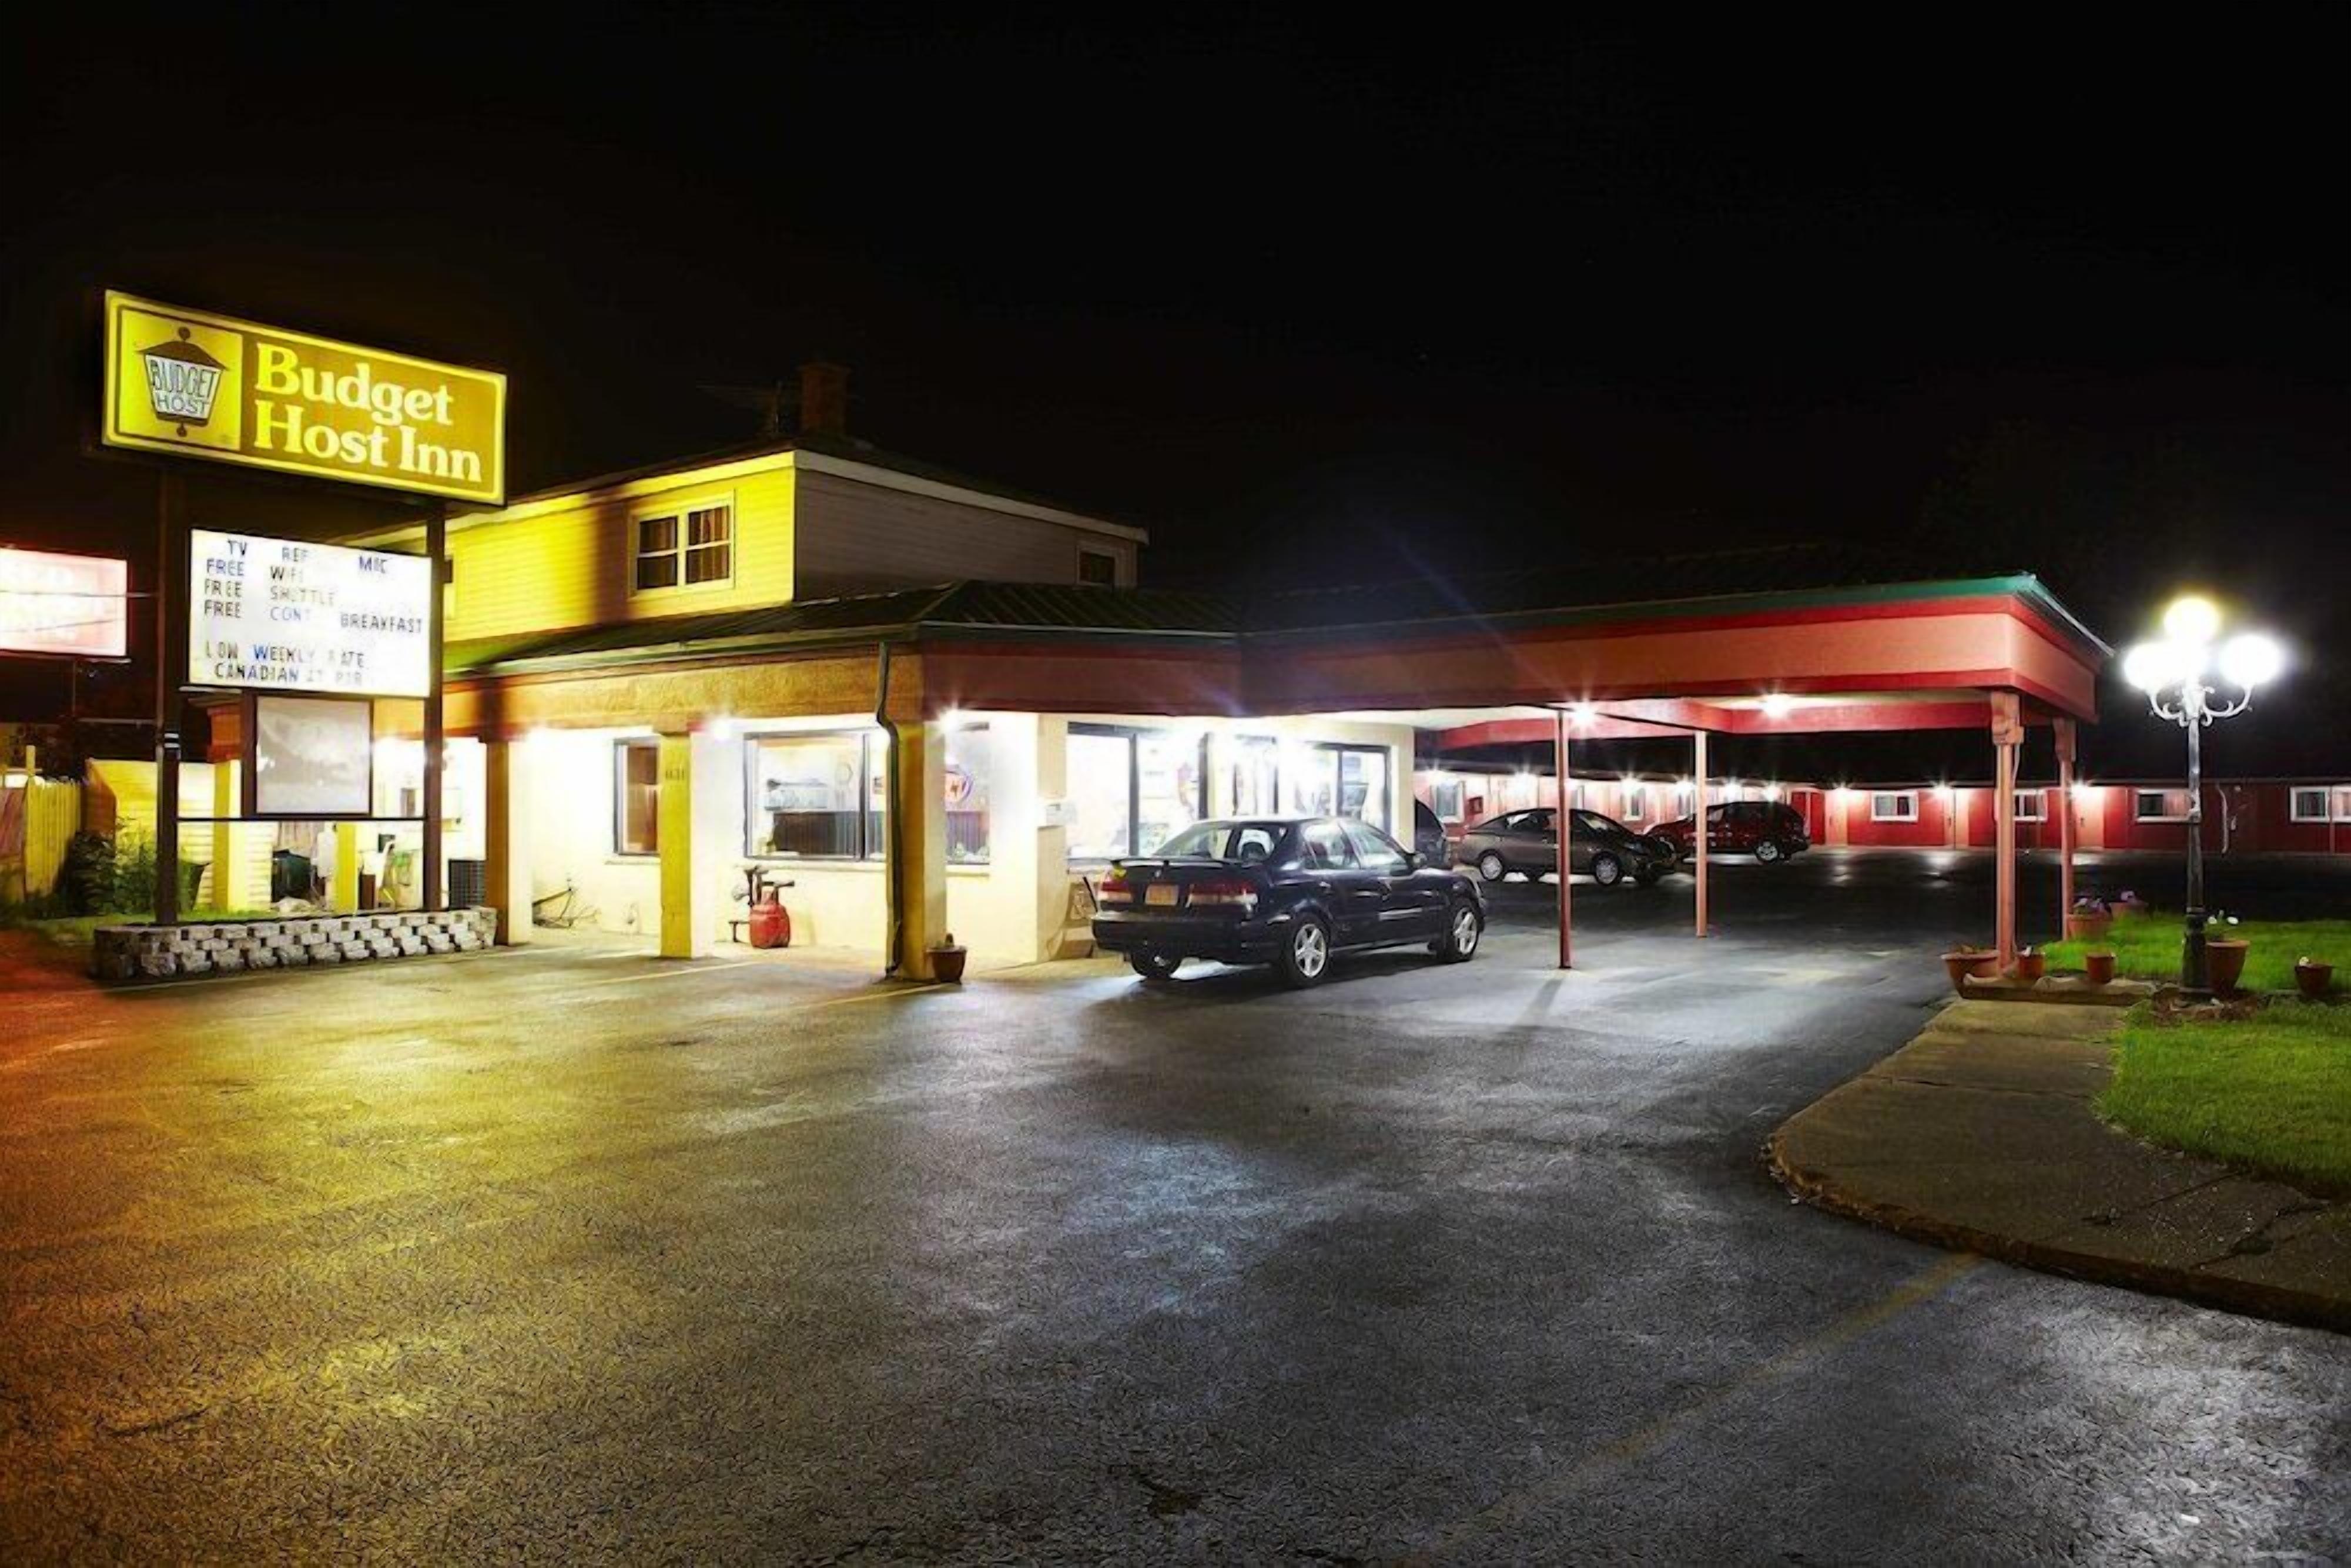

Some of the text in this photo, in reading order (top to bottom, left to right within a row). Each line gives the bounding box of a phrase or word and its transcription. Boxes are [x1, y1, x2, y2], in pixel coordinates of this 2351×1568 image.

[150, 359, 216, 398] BUDGET
[254, 343, 453, 426] Budget
[157, 393, 209, 414] HOST
[254, 400, 482, 483] Host Inn
[227, 539, 247, 556] TV
[206, 558, 245, 577] FREE
[204, 578, 243, 598] FREE
[204, 599, 241, 618] FREE
[340, 613, 423, 633] BREAKFAST
[253, 644, 316, 664] WEEKLY
[215, 662, 299, 682] CANADIAN
